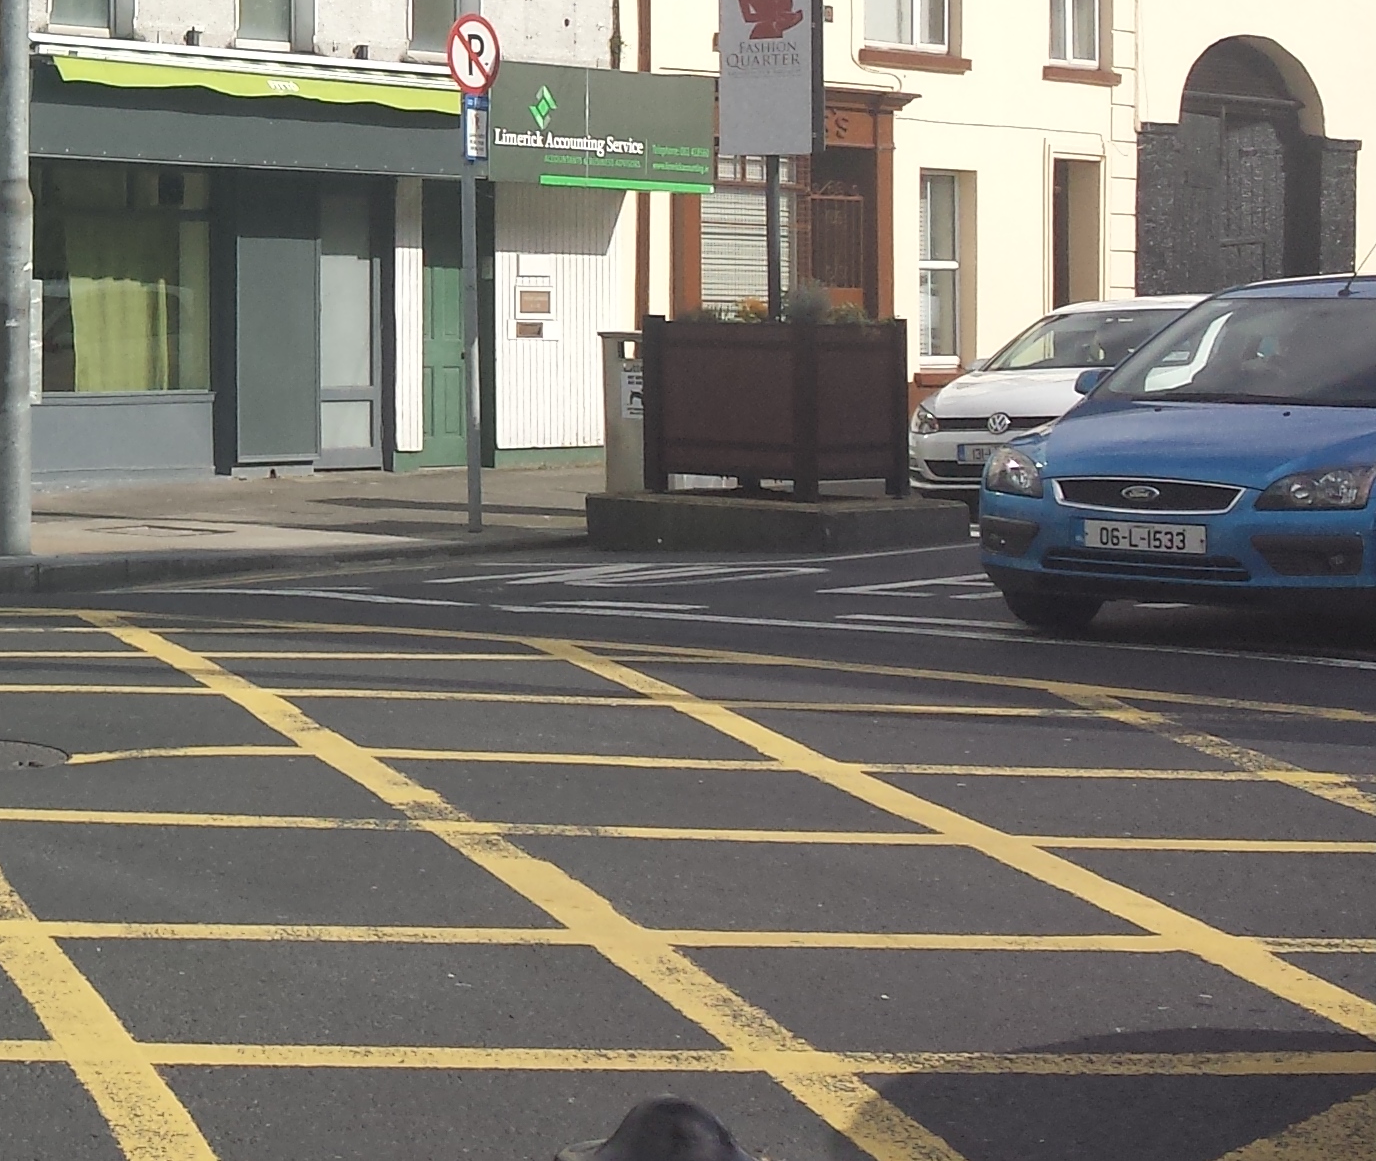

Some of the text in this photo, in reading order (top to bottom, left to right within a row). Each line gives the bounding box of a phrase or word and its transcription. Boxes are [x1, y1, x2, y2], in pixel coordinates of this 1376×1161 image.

[739, 41, 797, 54] FASHION
[726, 53, 800, 70] QUARTER
[494, 127, 544, 147] Limerick
[545, 131, 605, 157] Accounting
[606, 136, 644, 154] Service
[1099, 527, 1186, 550] 06-L-1533
